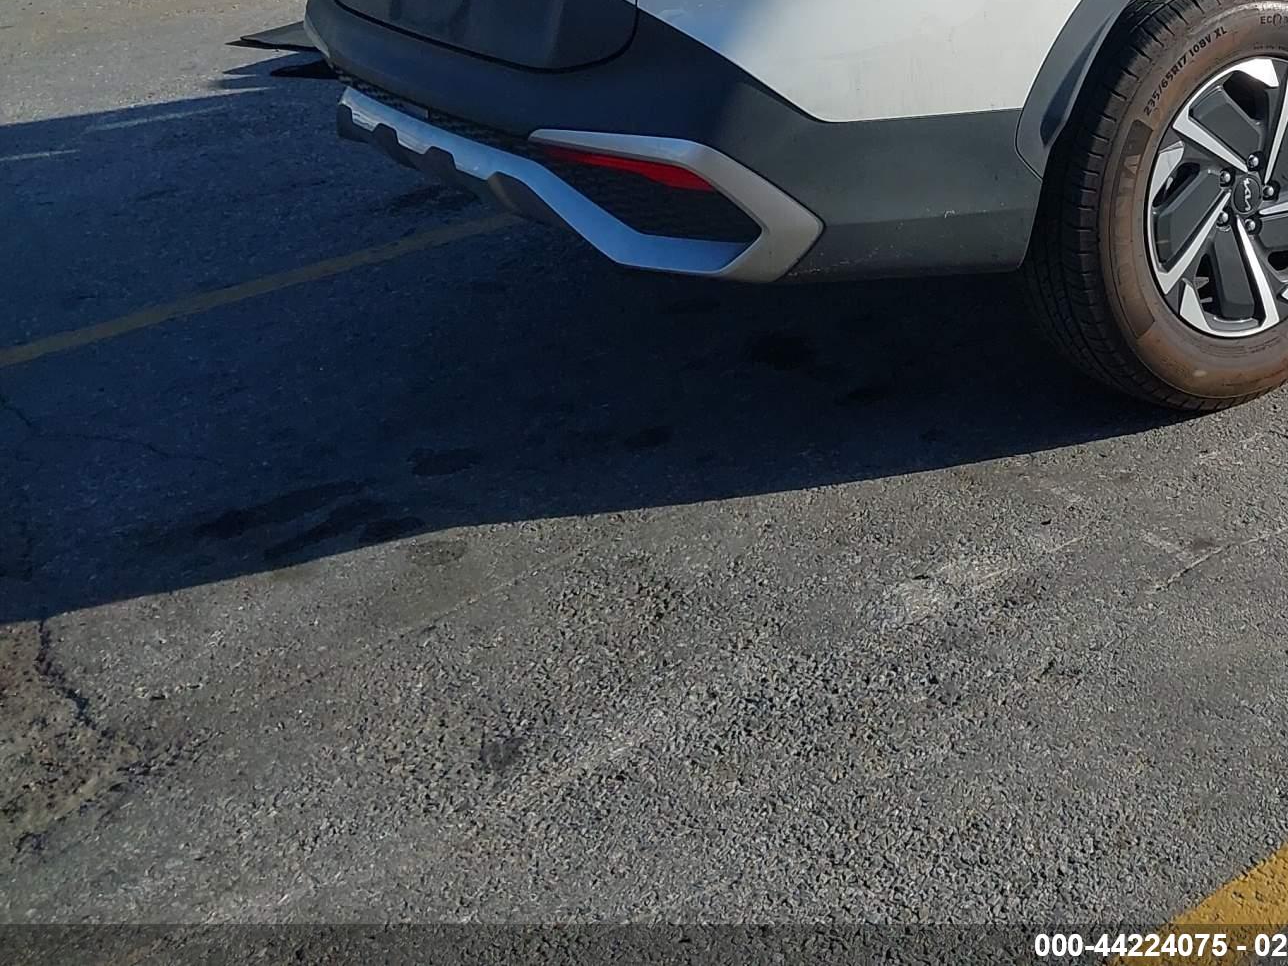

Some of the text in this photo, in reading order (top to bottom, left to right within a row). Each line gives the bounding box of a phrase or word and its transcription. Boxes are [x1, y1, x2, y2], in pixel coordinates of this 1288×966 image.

[1143, 25, 1228, 117] 235/65R17 108V XL
